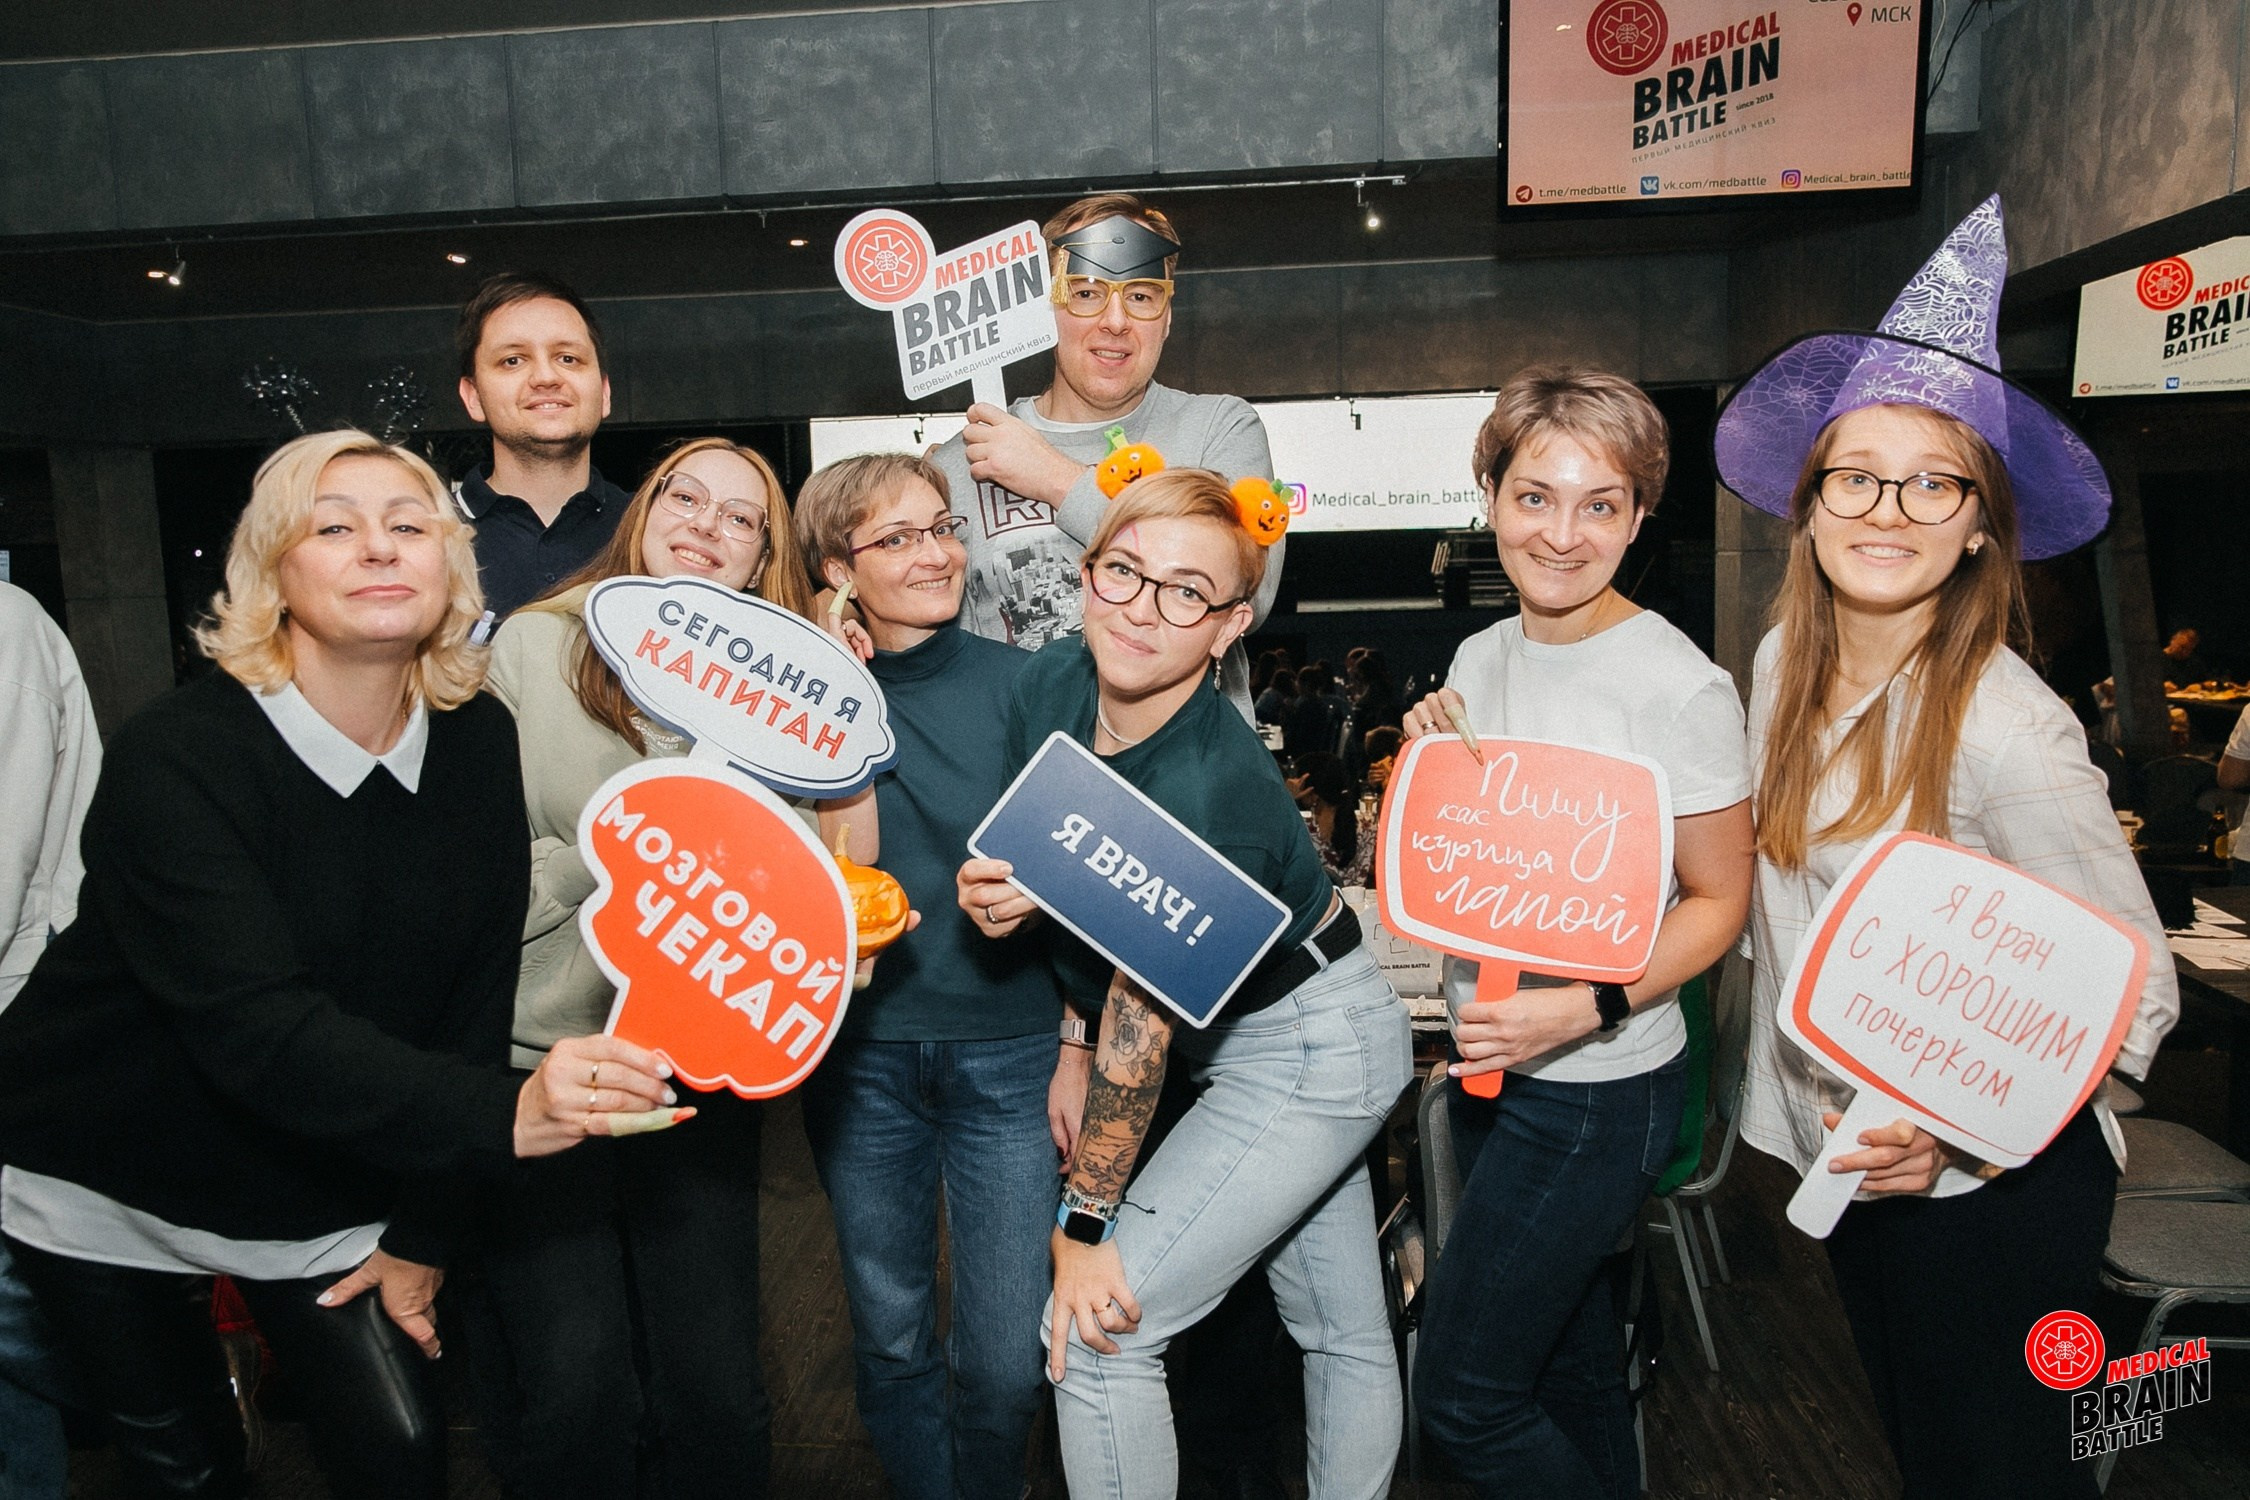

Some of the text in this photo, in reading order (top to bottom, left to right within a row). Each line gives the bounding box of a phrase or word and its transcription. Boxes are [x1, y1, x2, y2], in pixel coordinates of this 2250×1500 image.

[1671, 11, 1780, 67] MEDICAL
[1871, 5, 1912, 23] МСК
[1633, 36, 1780, 124] BRAIN
[1736, 93, 1774, 111] since 2018
[1631, 117, 1776, 164] ПЕРВЫЙ МЕДИЦИНСКИЙ КВИЗ
[1633, 100, 1727, 150] BATTLE
[1539, 184, 1627, 199] t.me/medbattle
[1663, 176, 1767, 191] vk.com/medbattle
[935, 231, 1038, 291] MEDICAL
[903, 255, 1044, 350] BRAIN
[2165, 291, 2250, 342] BRAI
[909, 321, 1000, 376] BATTLE
[913, 334, 1052, 394] первый медицинский квиз
[2163, 328, 2230, 360] BATTLE
[658, 600, 862, 723] СЕГОДНЯ Я
[635, 628, 847, 760] КАПИТАН
[1051, 813, 1095, 854] Я
[1436, 803, 1490, 826] как
[1480, 751, 1632, 882] Пишу
[1412, 831, 1553, 880] курица
[597, 795, 843, 1004] МОЗГОВОЙ
[1435, 876, 1640, 945] лапой
[1970, 890, 2055, 971] врач
[635, 880, 825, 1061] ЧЕКАП
[1885, 934, 2090, 1073] ХОРОШИМ
[1844, 992, 2014, 1107] почерком
